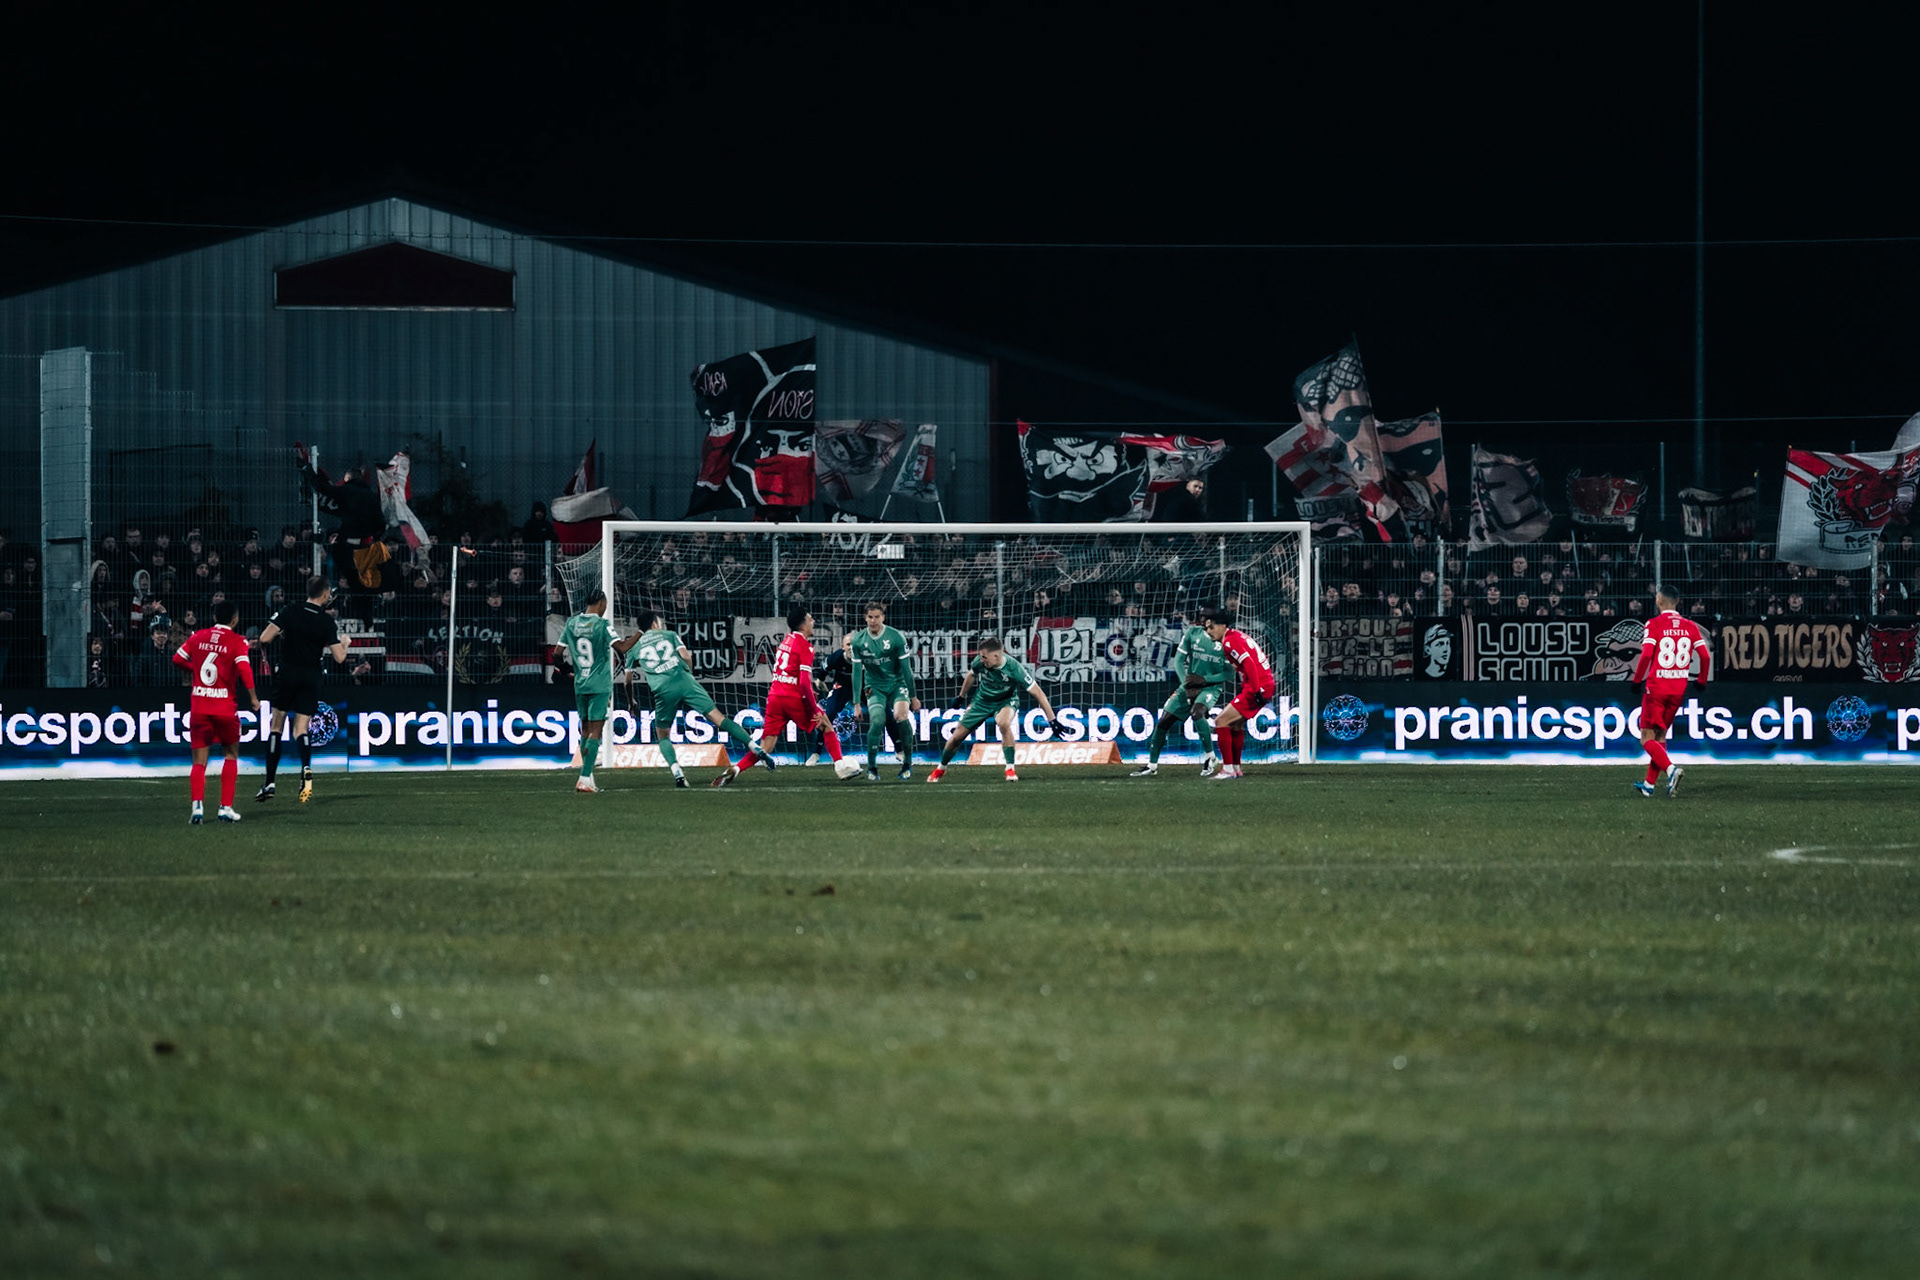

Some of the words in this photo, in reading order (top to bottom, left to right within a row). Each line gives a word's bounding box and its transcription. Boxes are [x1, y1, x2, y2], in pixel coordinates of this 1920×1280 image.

[198, 642, 228, 653] HESTIA
[577, 637, 595, 668] 9
[1477, 622, 1590, 655] LOUSY
[1658, 637, 1691, 669] 88
[1722, 625, 1770, 670] RED
[1774, 624, 1854, 669] TIGERS
[200, 651, 218, 687] 6
